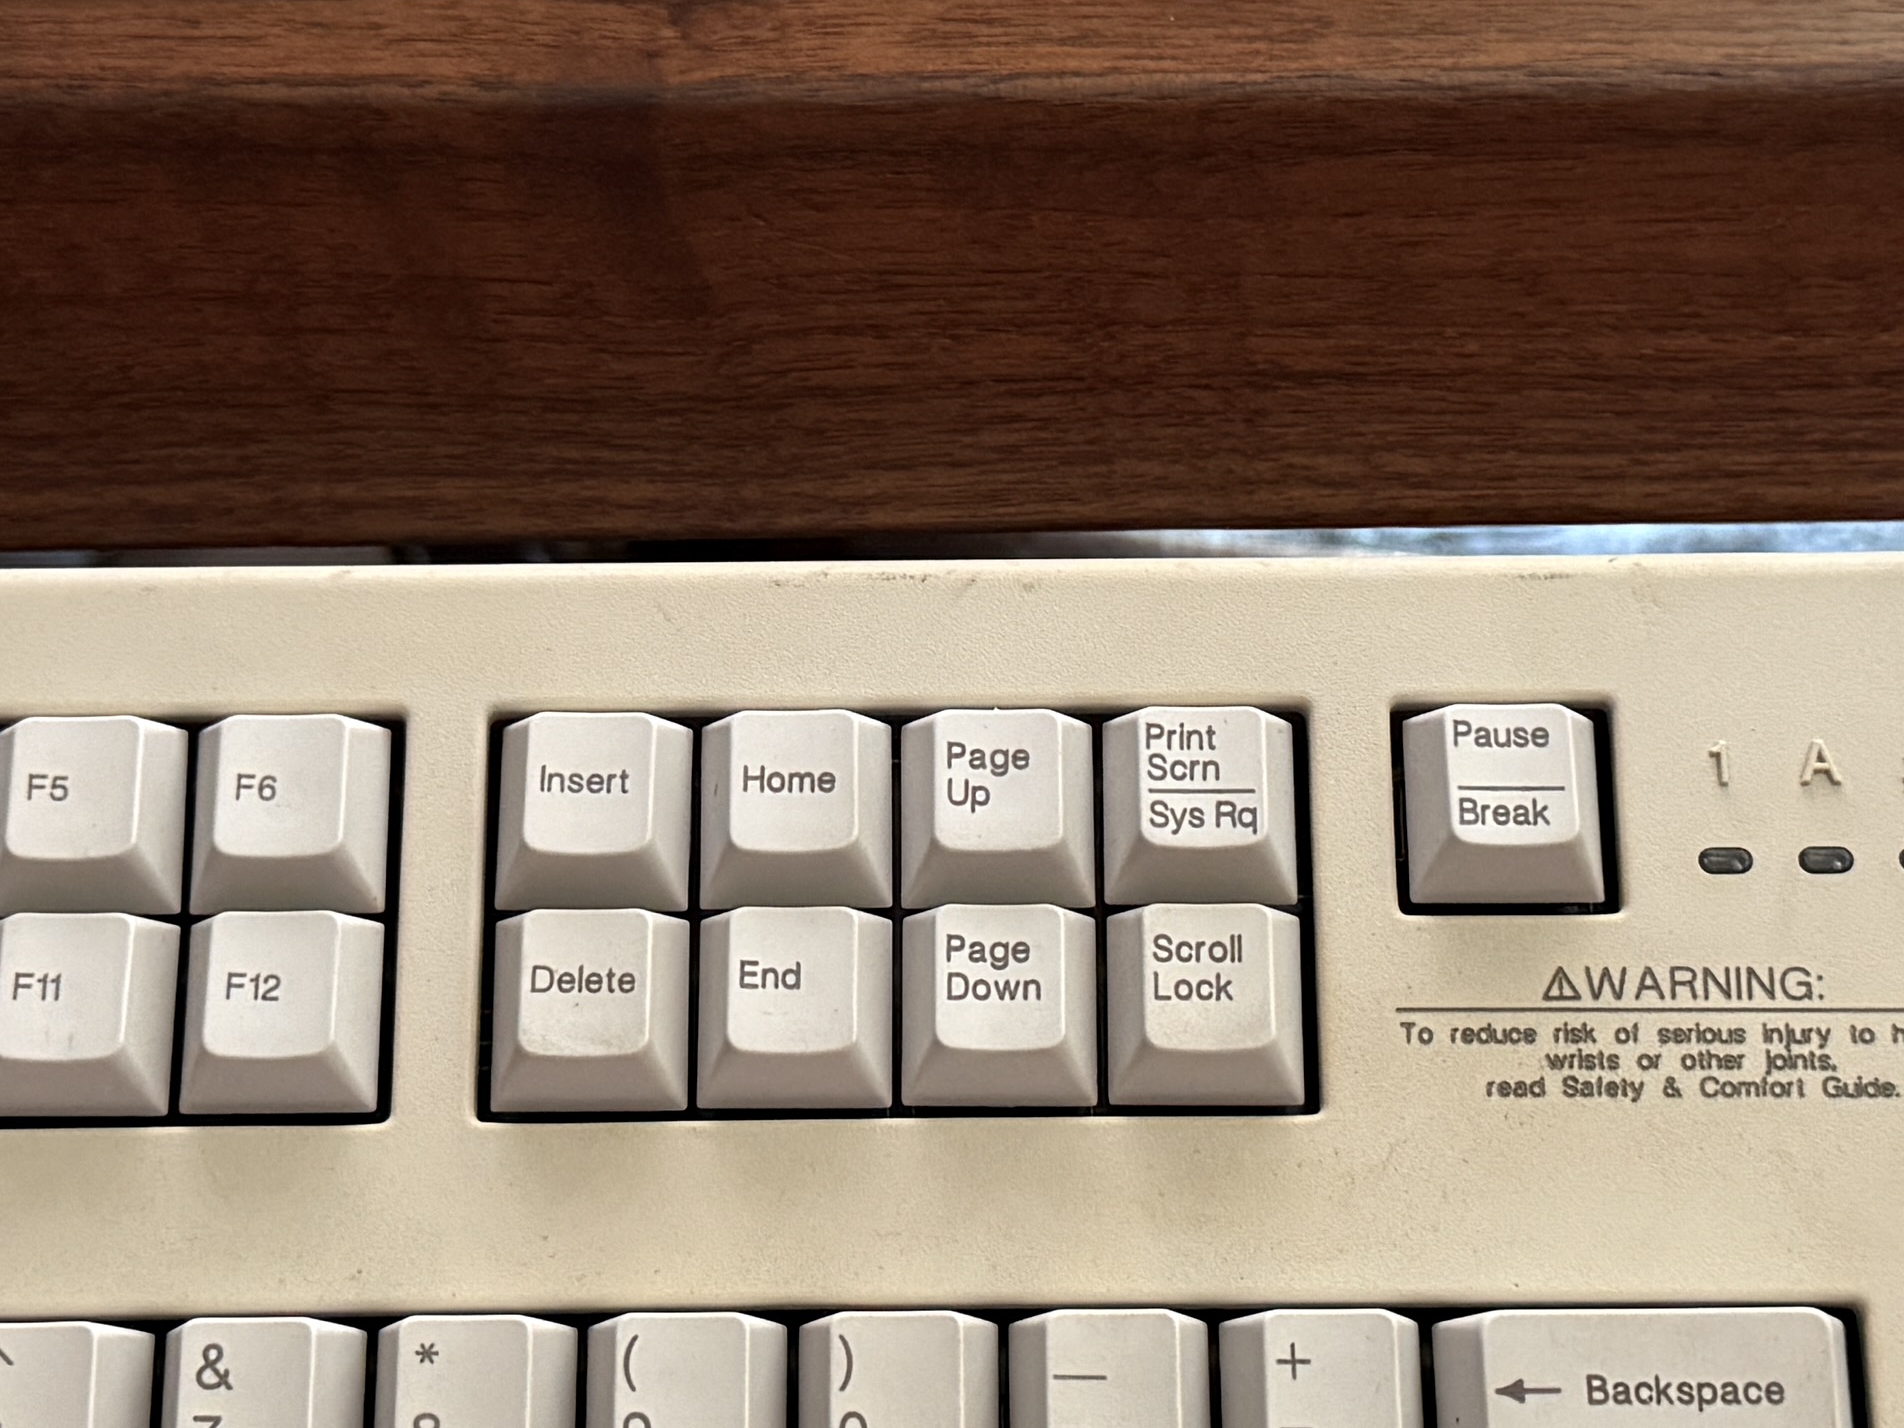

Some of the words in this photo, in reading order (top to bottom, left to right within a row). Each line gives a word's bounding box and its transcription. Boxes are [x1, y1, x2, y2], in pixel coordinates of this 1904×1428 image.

[1145, 721, 1217, 751] Print
[1452, 718, 1550, 749] Pause
[946, 740, 1030, 778] Page
[1146, 752, 1221, 782] Scrn
[26, 773, 69, 802] F5
[235, 772, 278, 802] F6
[539, 764, 630, 795] Insert
[742, 764, 837, 794] Home
[947, 777, 991, 813] Up
[1149, 799, 1206, 836] Sys
[1214, 799, 1258, 836] Rq
[1458, 796, 1551, 827] Break
[945, 933, 1031, 971] Page
[1152, 933, 1243, 964] Scroll
[11, 971, 62, 1002] F11
[225, 971, 282, 1002] F12
[530, 964, 636, 994] Delete
[738, 959, 802, 991] End
[946, 971, 1042, 1002] Down
[1153, 970, 1234, 1002] Lock
[1584, 965, 1825, 1002] WARNING:
[1399, 1021, 1434, 1046] To
[1449, 1022, 1538, 1046] reduce
[1552, 1021, 1598, 1046] risk
[1614, 1021, 1640, 1045] of
[1656, 1021, 1747, 1048] serious
[1761, 1022, 1832, 1054] injury
[1848, 1024, 1876, 1046] to
[1544, 1047, 1621, 1072] wrists
[1635, 1052, 1663, 1072] or
[1680, 1048, 1746, 1072] other
[1485, 1075, 1547, 1099] read
[1561, 1074, 1645, 1104] Safety
[1662, 1075, 1683, 1099] &
[1698, 1071, 1806, 1100] Comfort
[1821, 1075, 1902, 1100] Guide.
[1585, 1373, 1785, 1413] Backspace
